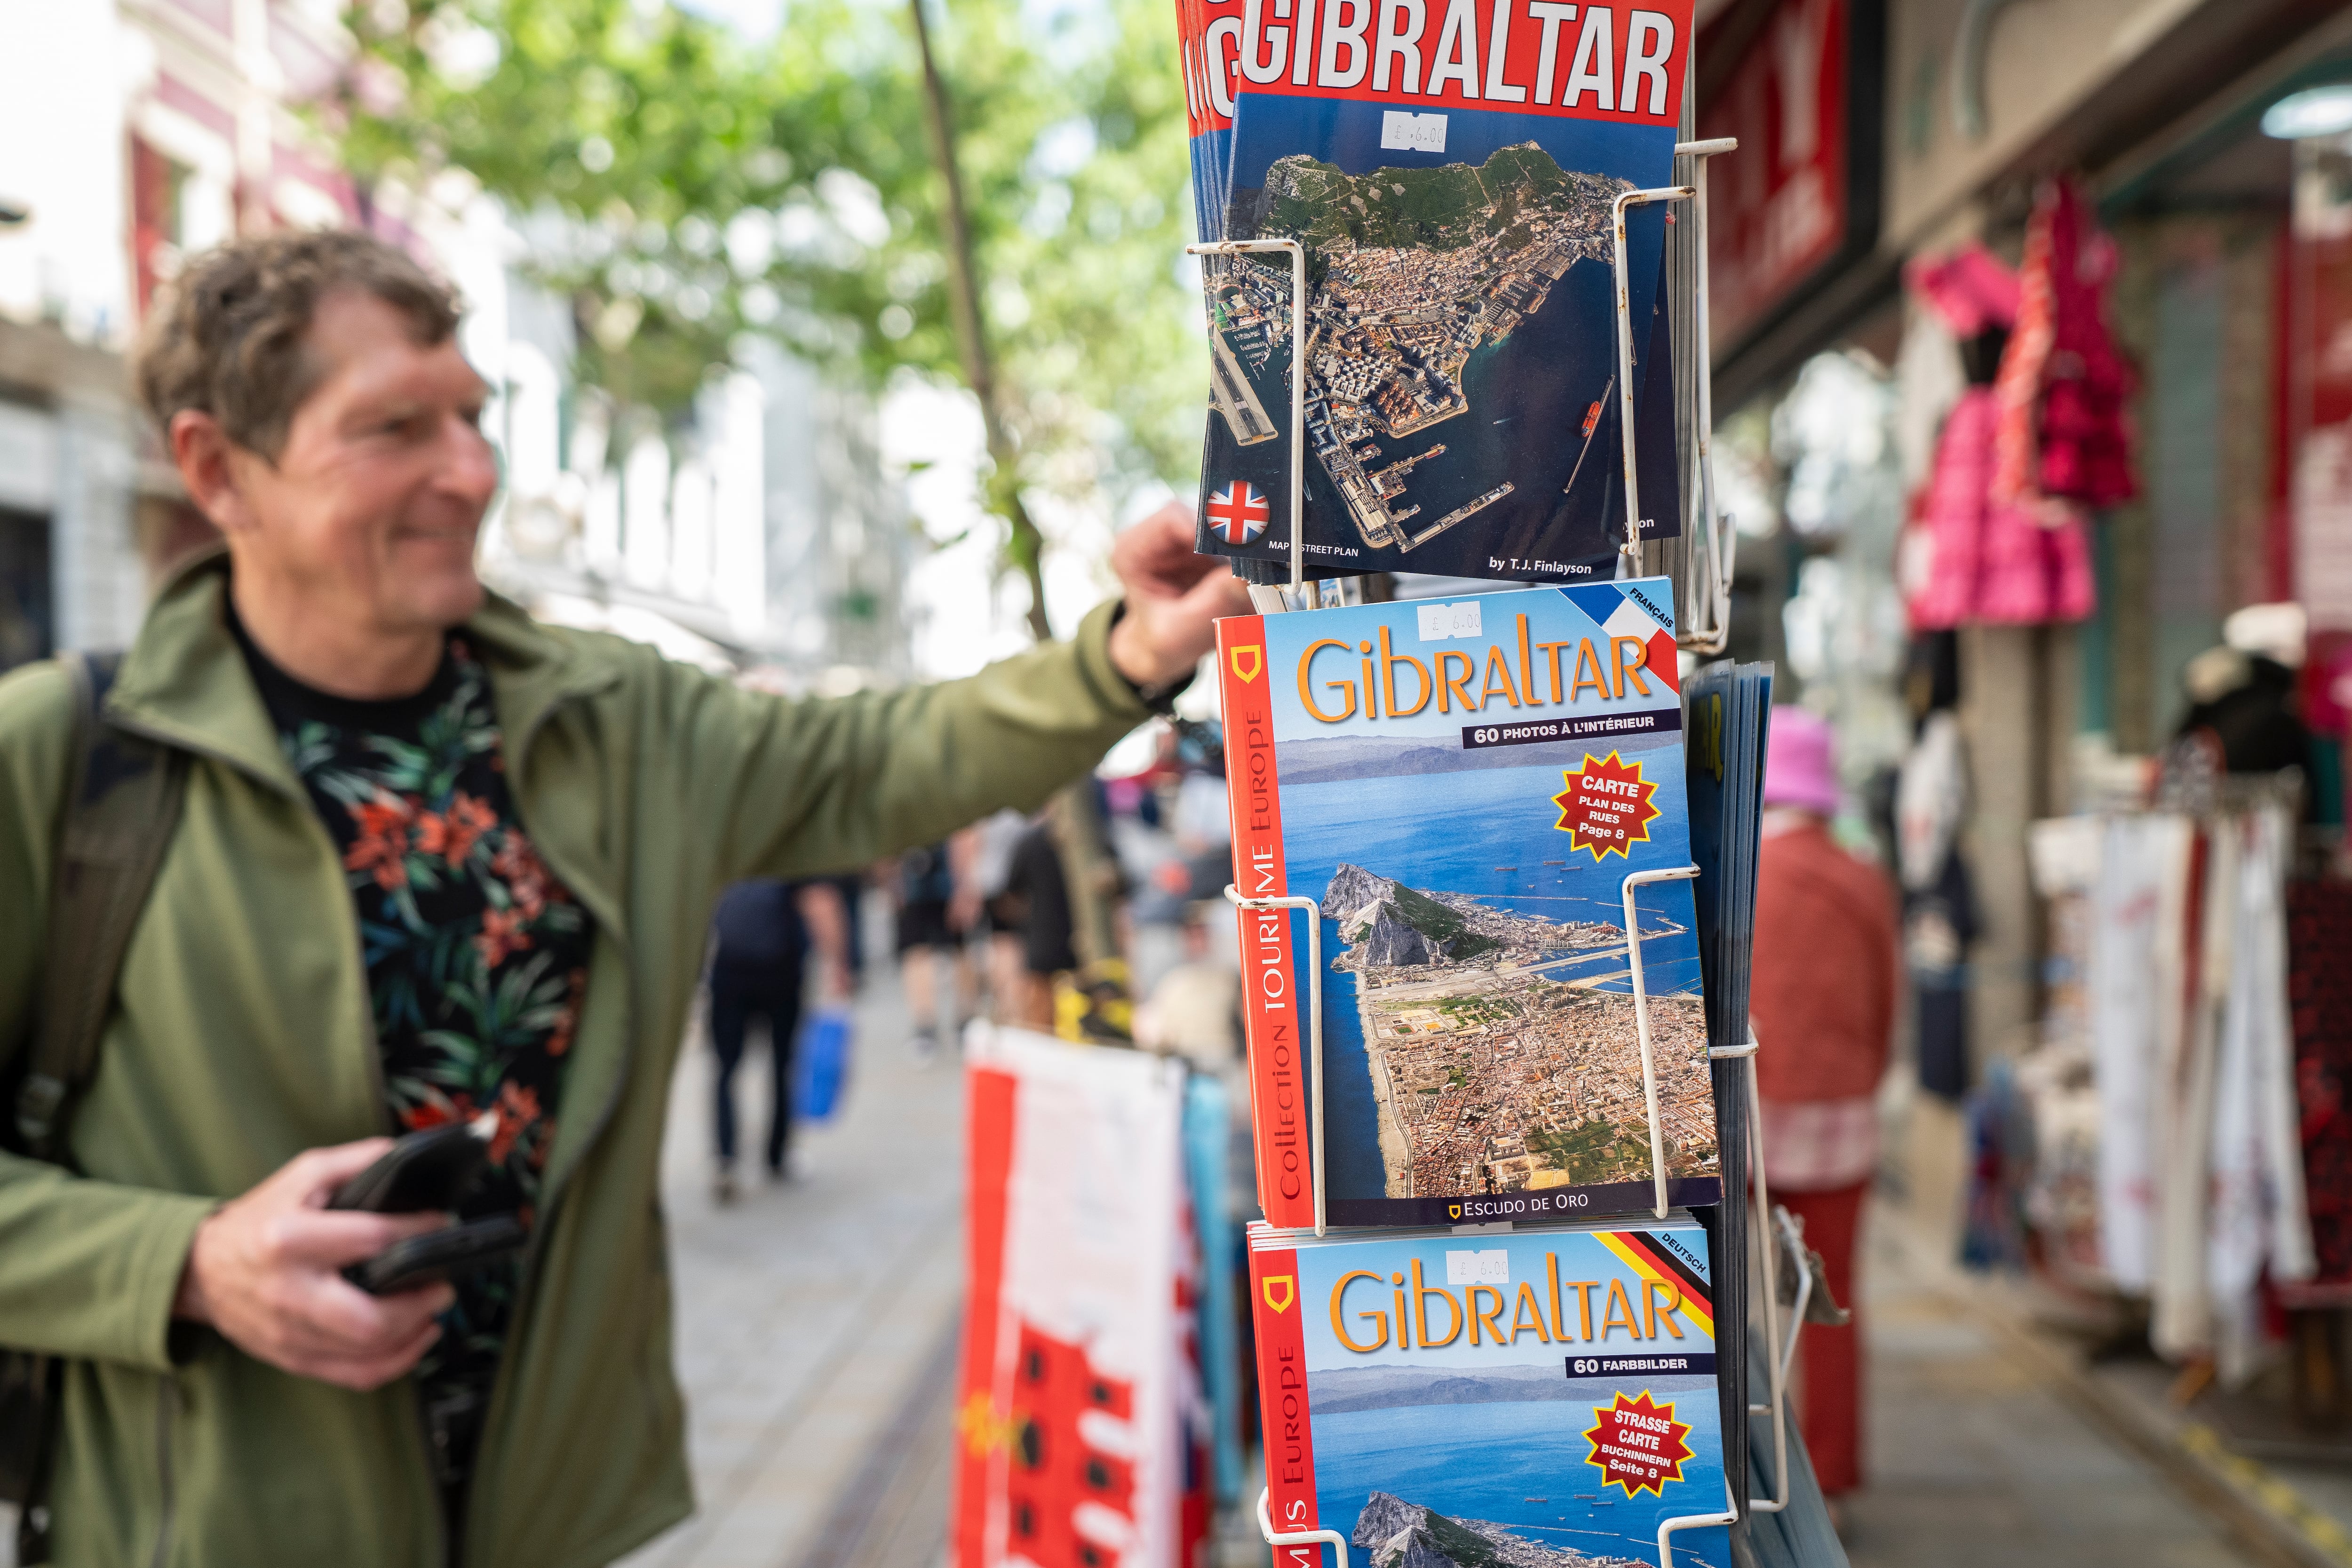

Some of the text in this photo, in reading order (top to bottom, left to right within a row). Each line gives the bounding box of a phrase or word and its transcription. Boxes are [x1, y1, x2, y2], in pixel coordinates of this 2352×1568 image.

[1241, 0, 1676, 116] GIBRALTAR
[1269, 541, 1290, 550] MAP
[1334, 547, 1359, 557] PLAN
[1489, 557, 1505, 571] by
[1534, 560, 1592, 576] Finlayson
[1629, 587, 1674, 628] FRANÇAIS
[1454, 614, 1480, 629] 6.00
[1474, 728, 1499, 743] 60
[1503, 725, 1558, 740] PHOTOS
[1561, 722, 1571, 734] À
[1581, 775, 1640, 798] CARTE
[1579, 796, 1635, 813] PLAN DES
[1589, 811, 1620, 824] RUES
[1579, 822, 1625, 839] Page 8
[1464, 1194, 1589, 1216] ESCUDO DE ORO
[1661, 1233, 1707, 1273] DEUTSCH
[1481, 1261, 1507, 1275] 6.00
[1574, 1359, 1688, 1373] 60 FARBBILDER
[1614, 1409, 1671, 1434] STRASSE
[1619, 1429, 1661, 1450] CARTE
[1601, 1444, 1671, 1467] BUCHINNERN
[1609, 1459, 1658, 1478] Seite 8
[1286, 1500, 1311, 1568] MS
